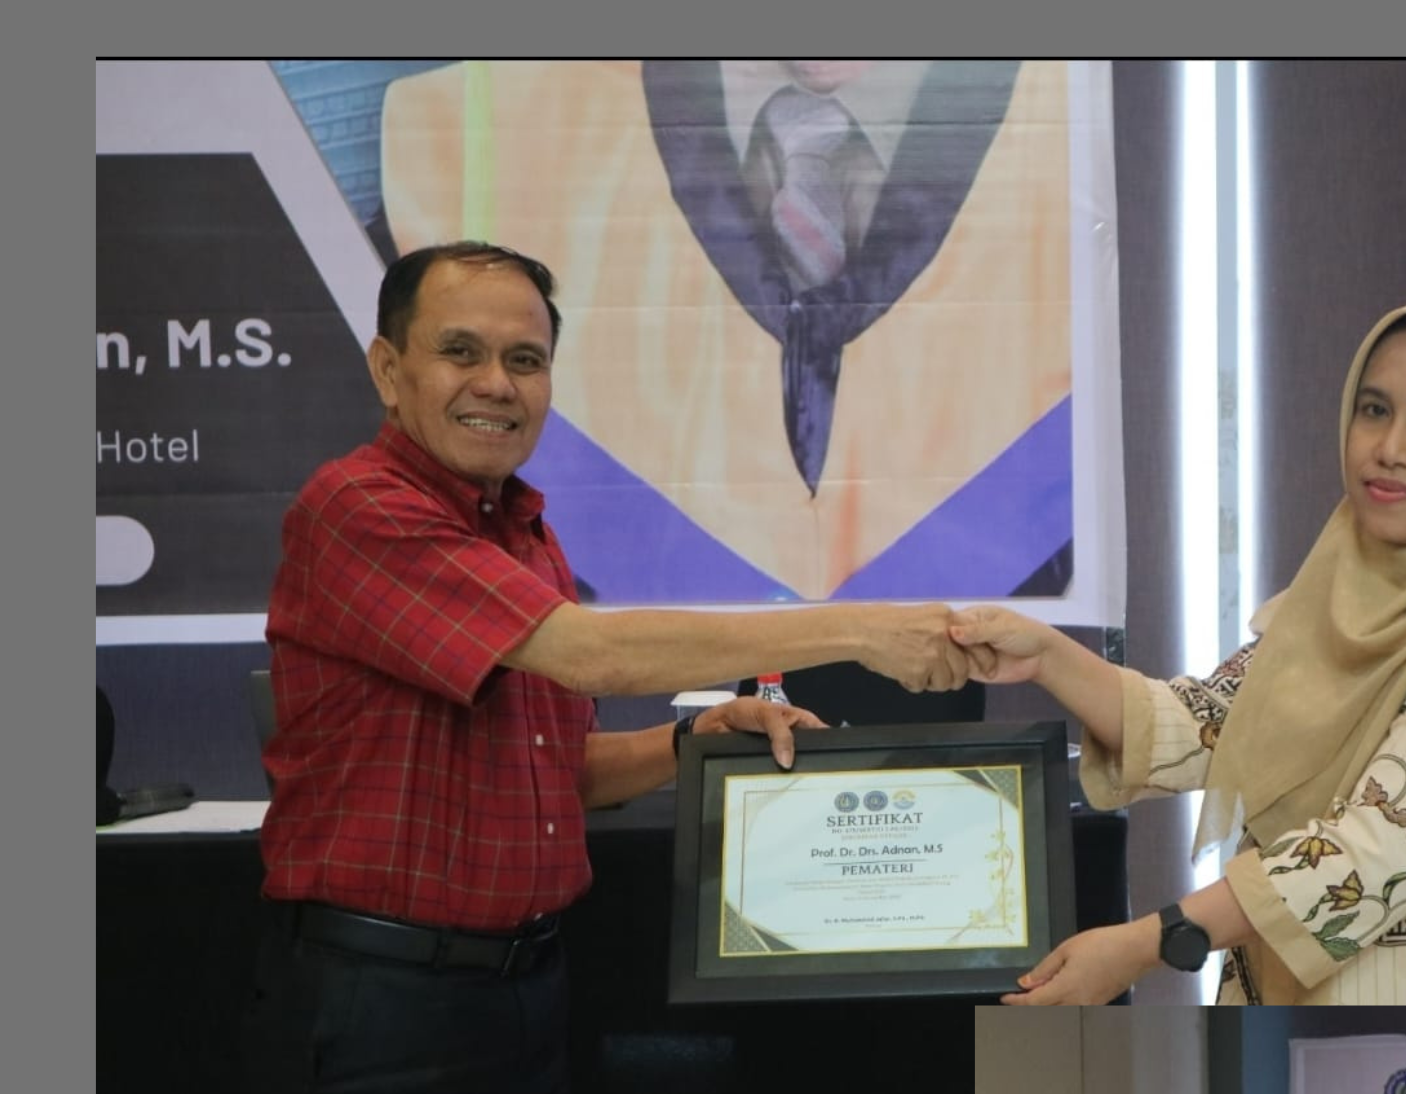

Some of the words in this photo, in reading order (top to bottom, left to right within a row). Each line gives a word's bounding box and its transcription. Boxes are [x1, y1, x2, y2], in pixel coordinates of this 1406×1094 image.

[167, 317, 291, 367] M.S.
[97, 428, 199, 463] Hotel
[826, 811, 924, 828] SERTIFIKAT
[811, 847, 837, 859] Prof.
[840, 847, 857, 858] Dr.
[841, 862, 913, 876] PEMATERI
